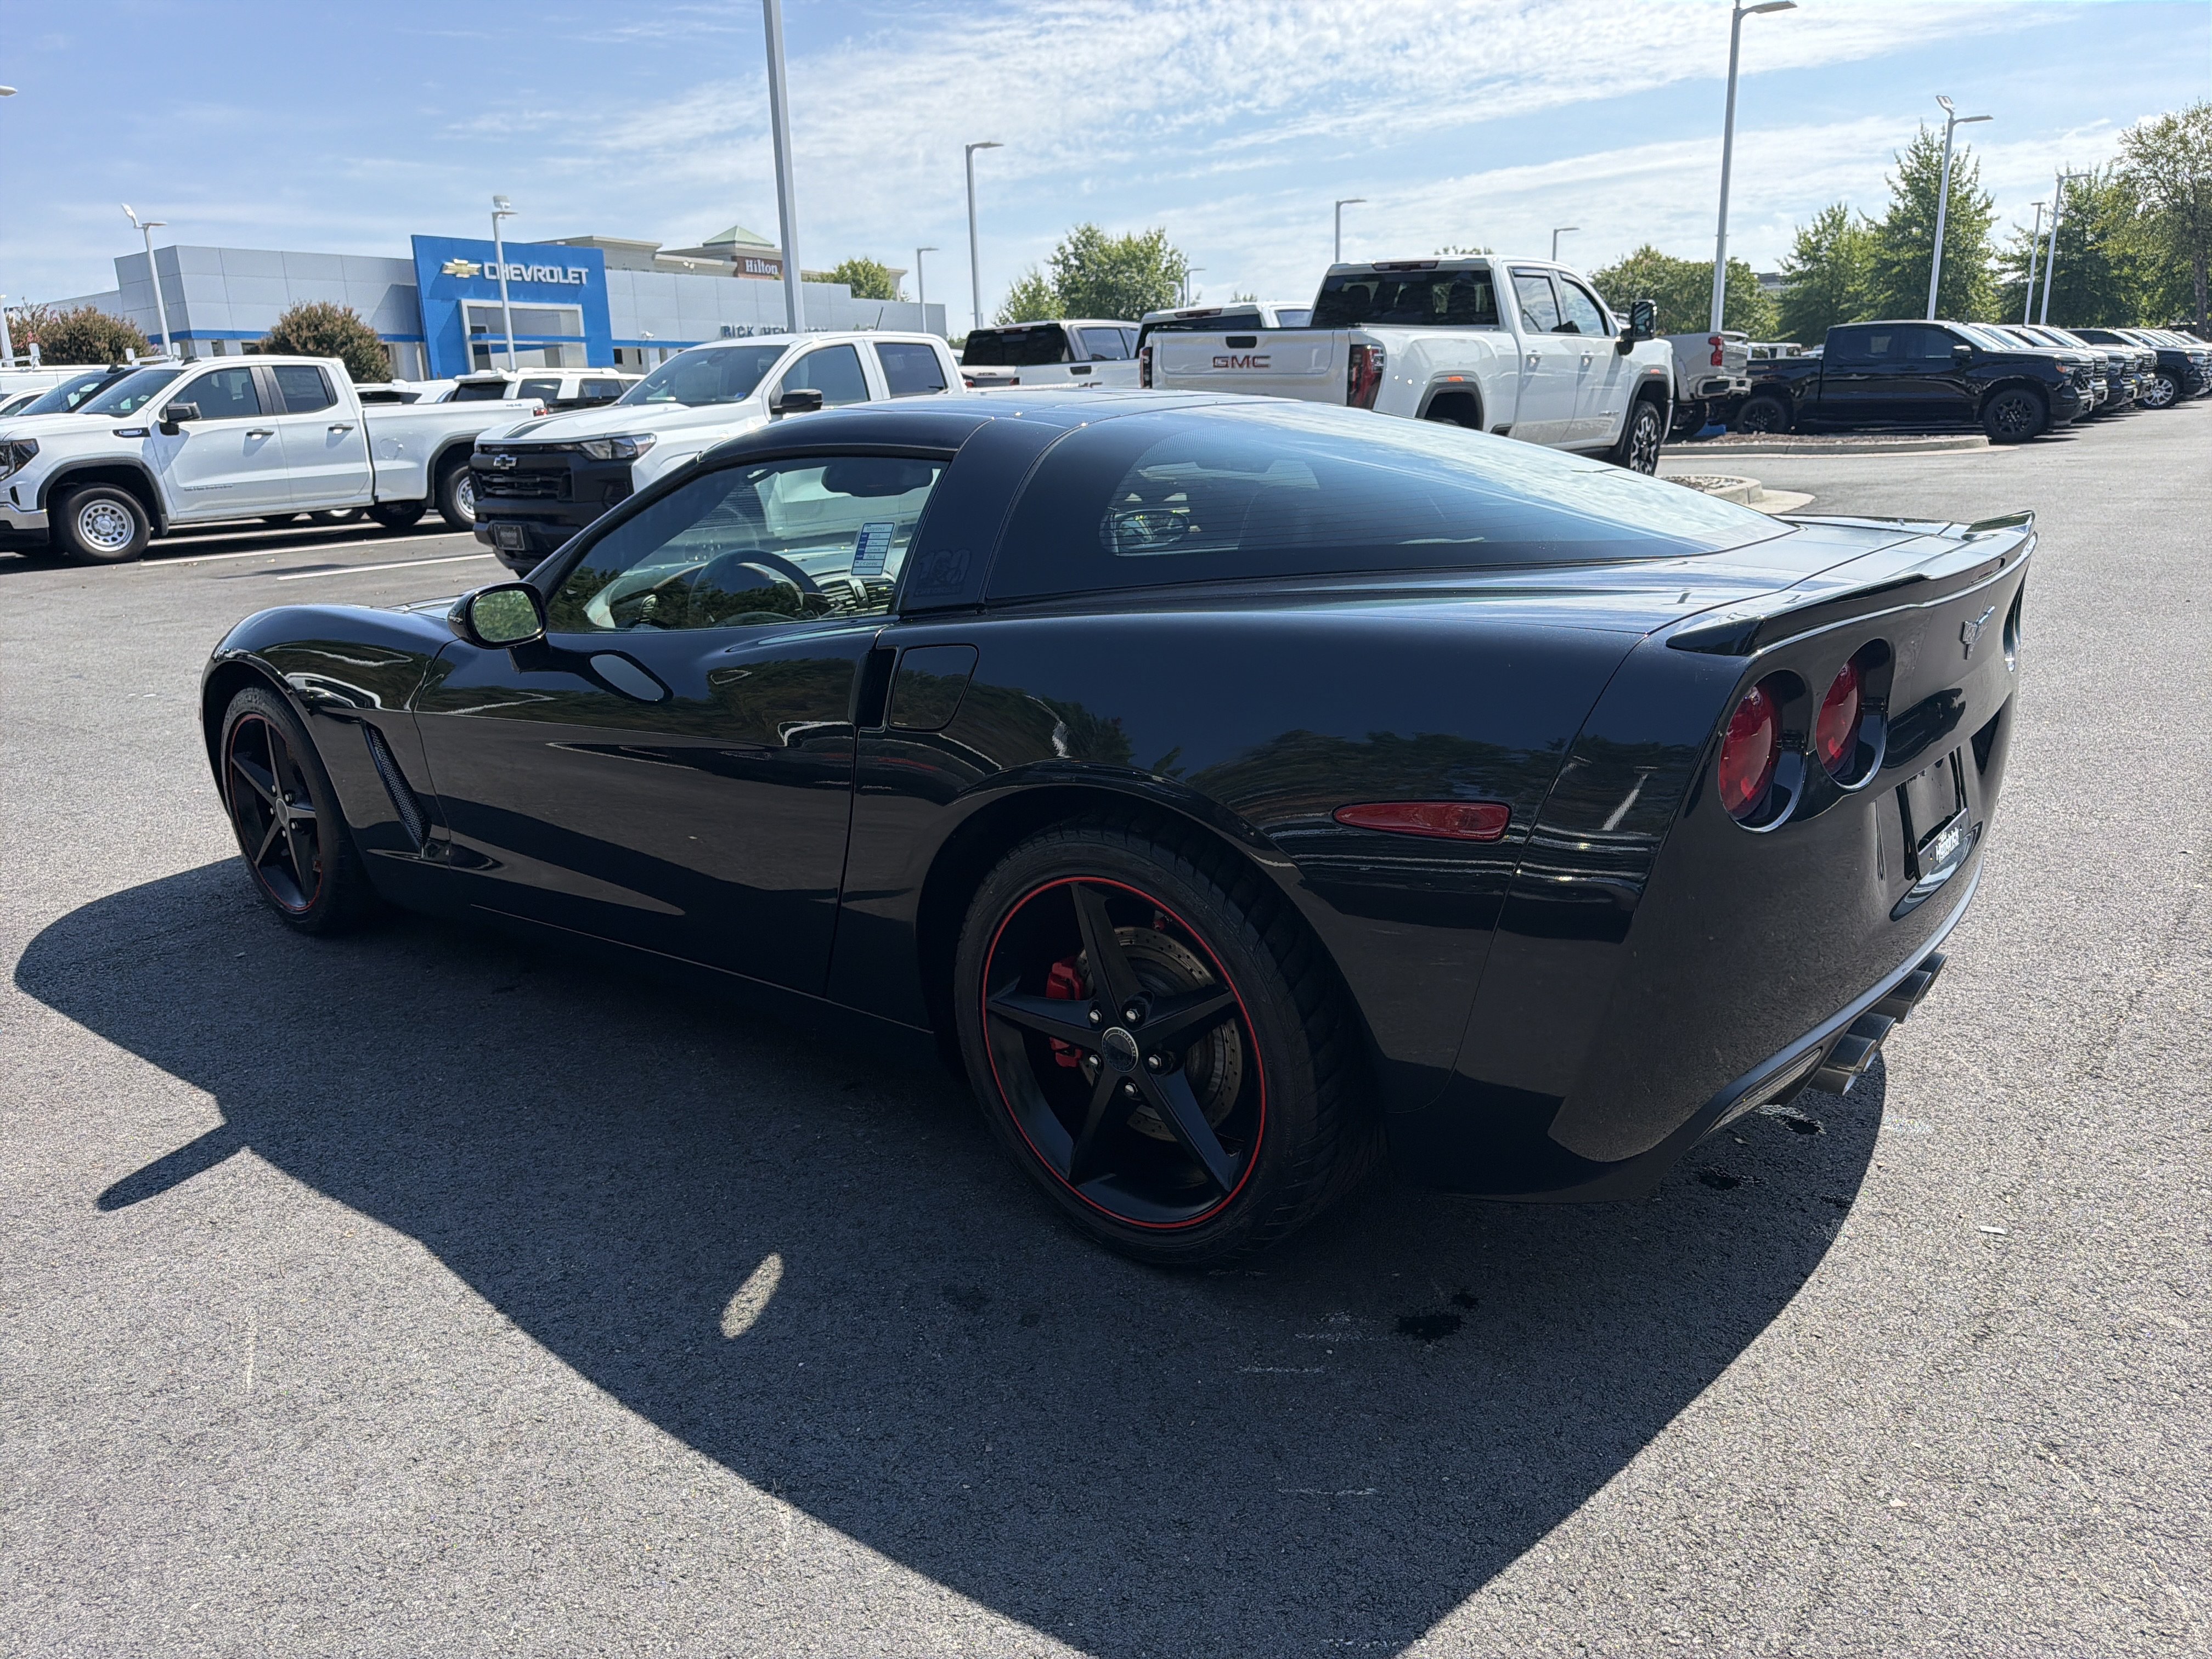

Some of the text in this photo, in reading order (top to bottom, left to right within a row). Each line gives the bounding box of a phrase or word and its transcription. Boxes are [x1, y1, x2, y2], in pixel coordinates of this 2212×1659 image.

[484, 262, 589, 285] CHEVROLET
[745, 259, 778, 275] Hilton
[720, 325, 754, 338] RICK
[1213, 355, 1271, 368] GMC
